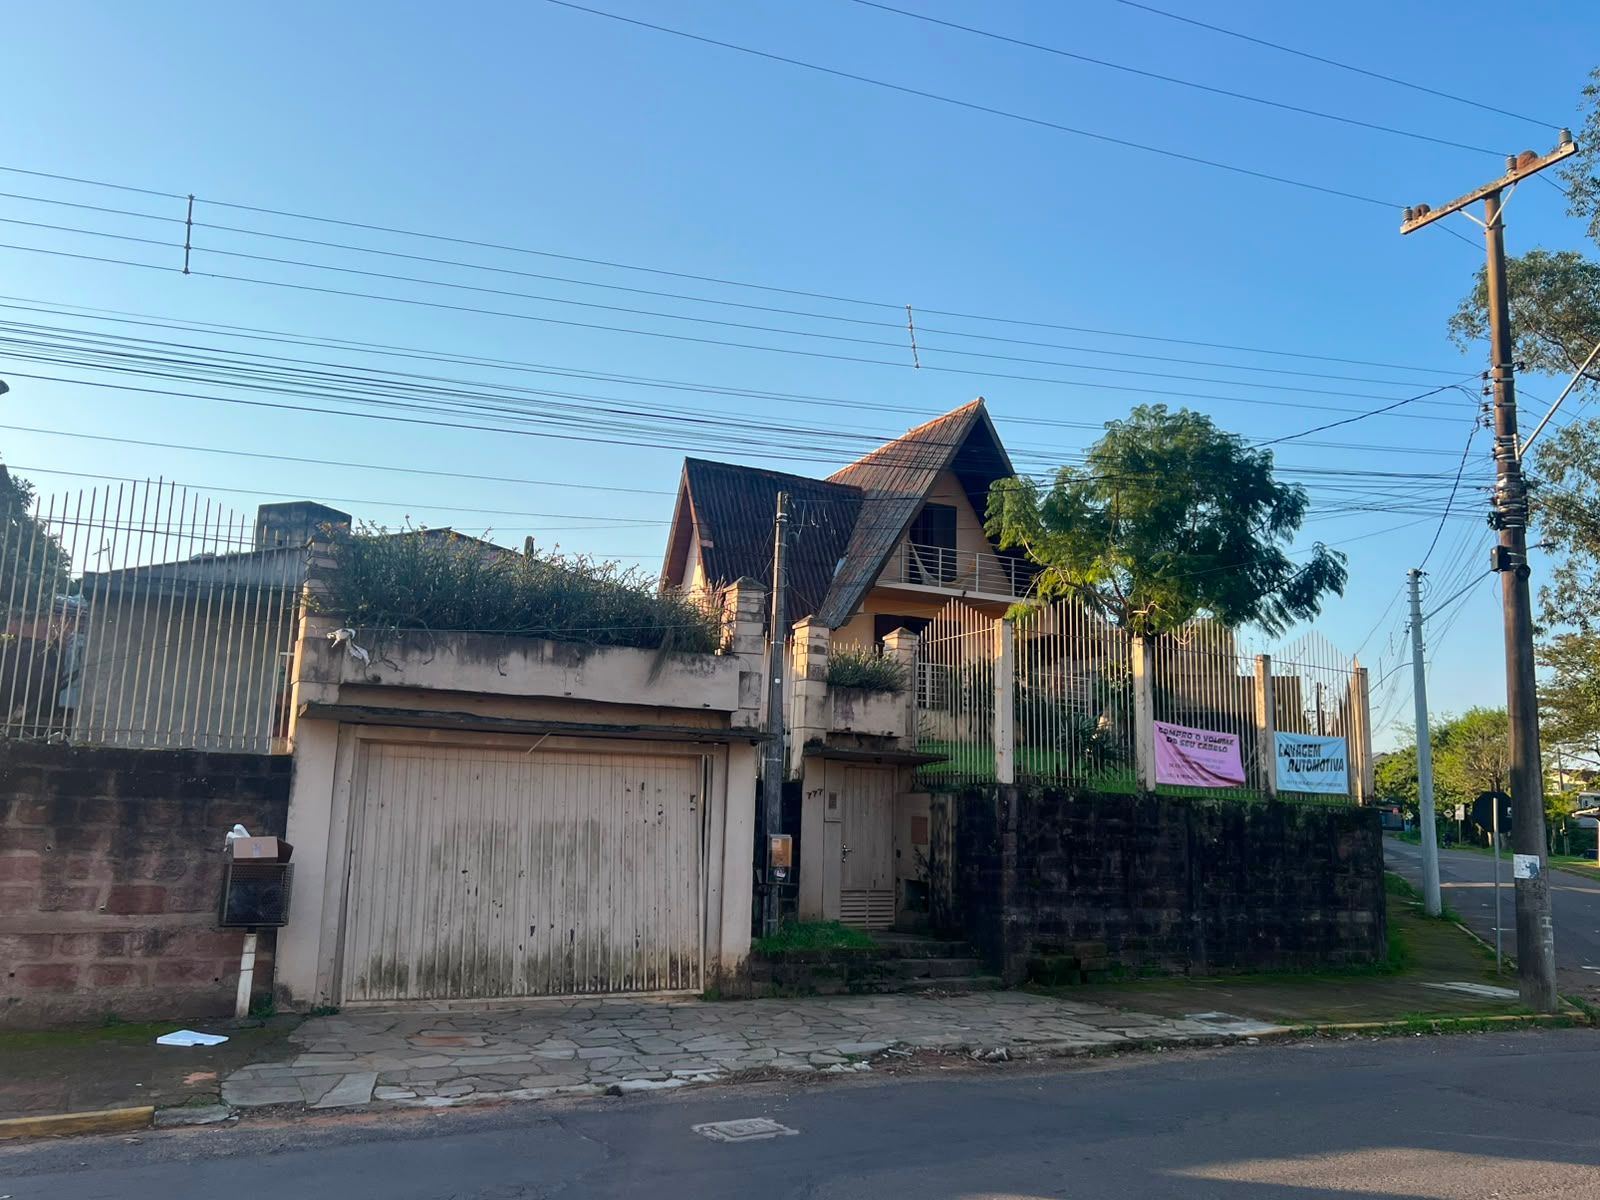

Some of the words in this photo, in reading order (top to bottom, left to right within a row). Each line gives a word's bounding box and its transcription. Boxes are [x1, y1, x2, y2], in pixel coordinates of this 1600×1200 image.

[1180, 739, 1196, 748] SEU
[1197, 742, 1228, 753] CABELO
[1278, 743, 1322, 758] LAVAGEM
[1287, 758, 1344, 773] AUTOMOTIVA
[806, 788, 823, 799] 777
